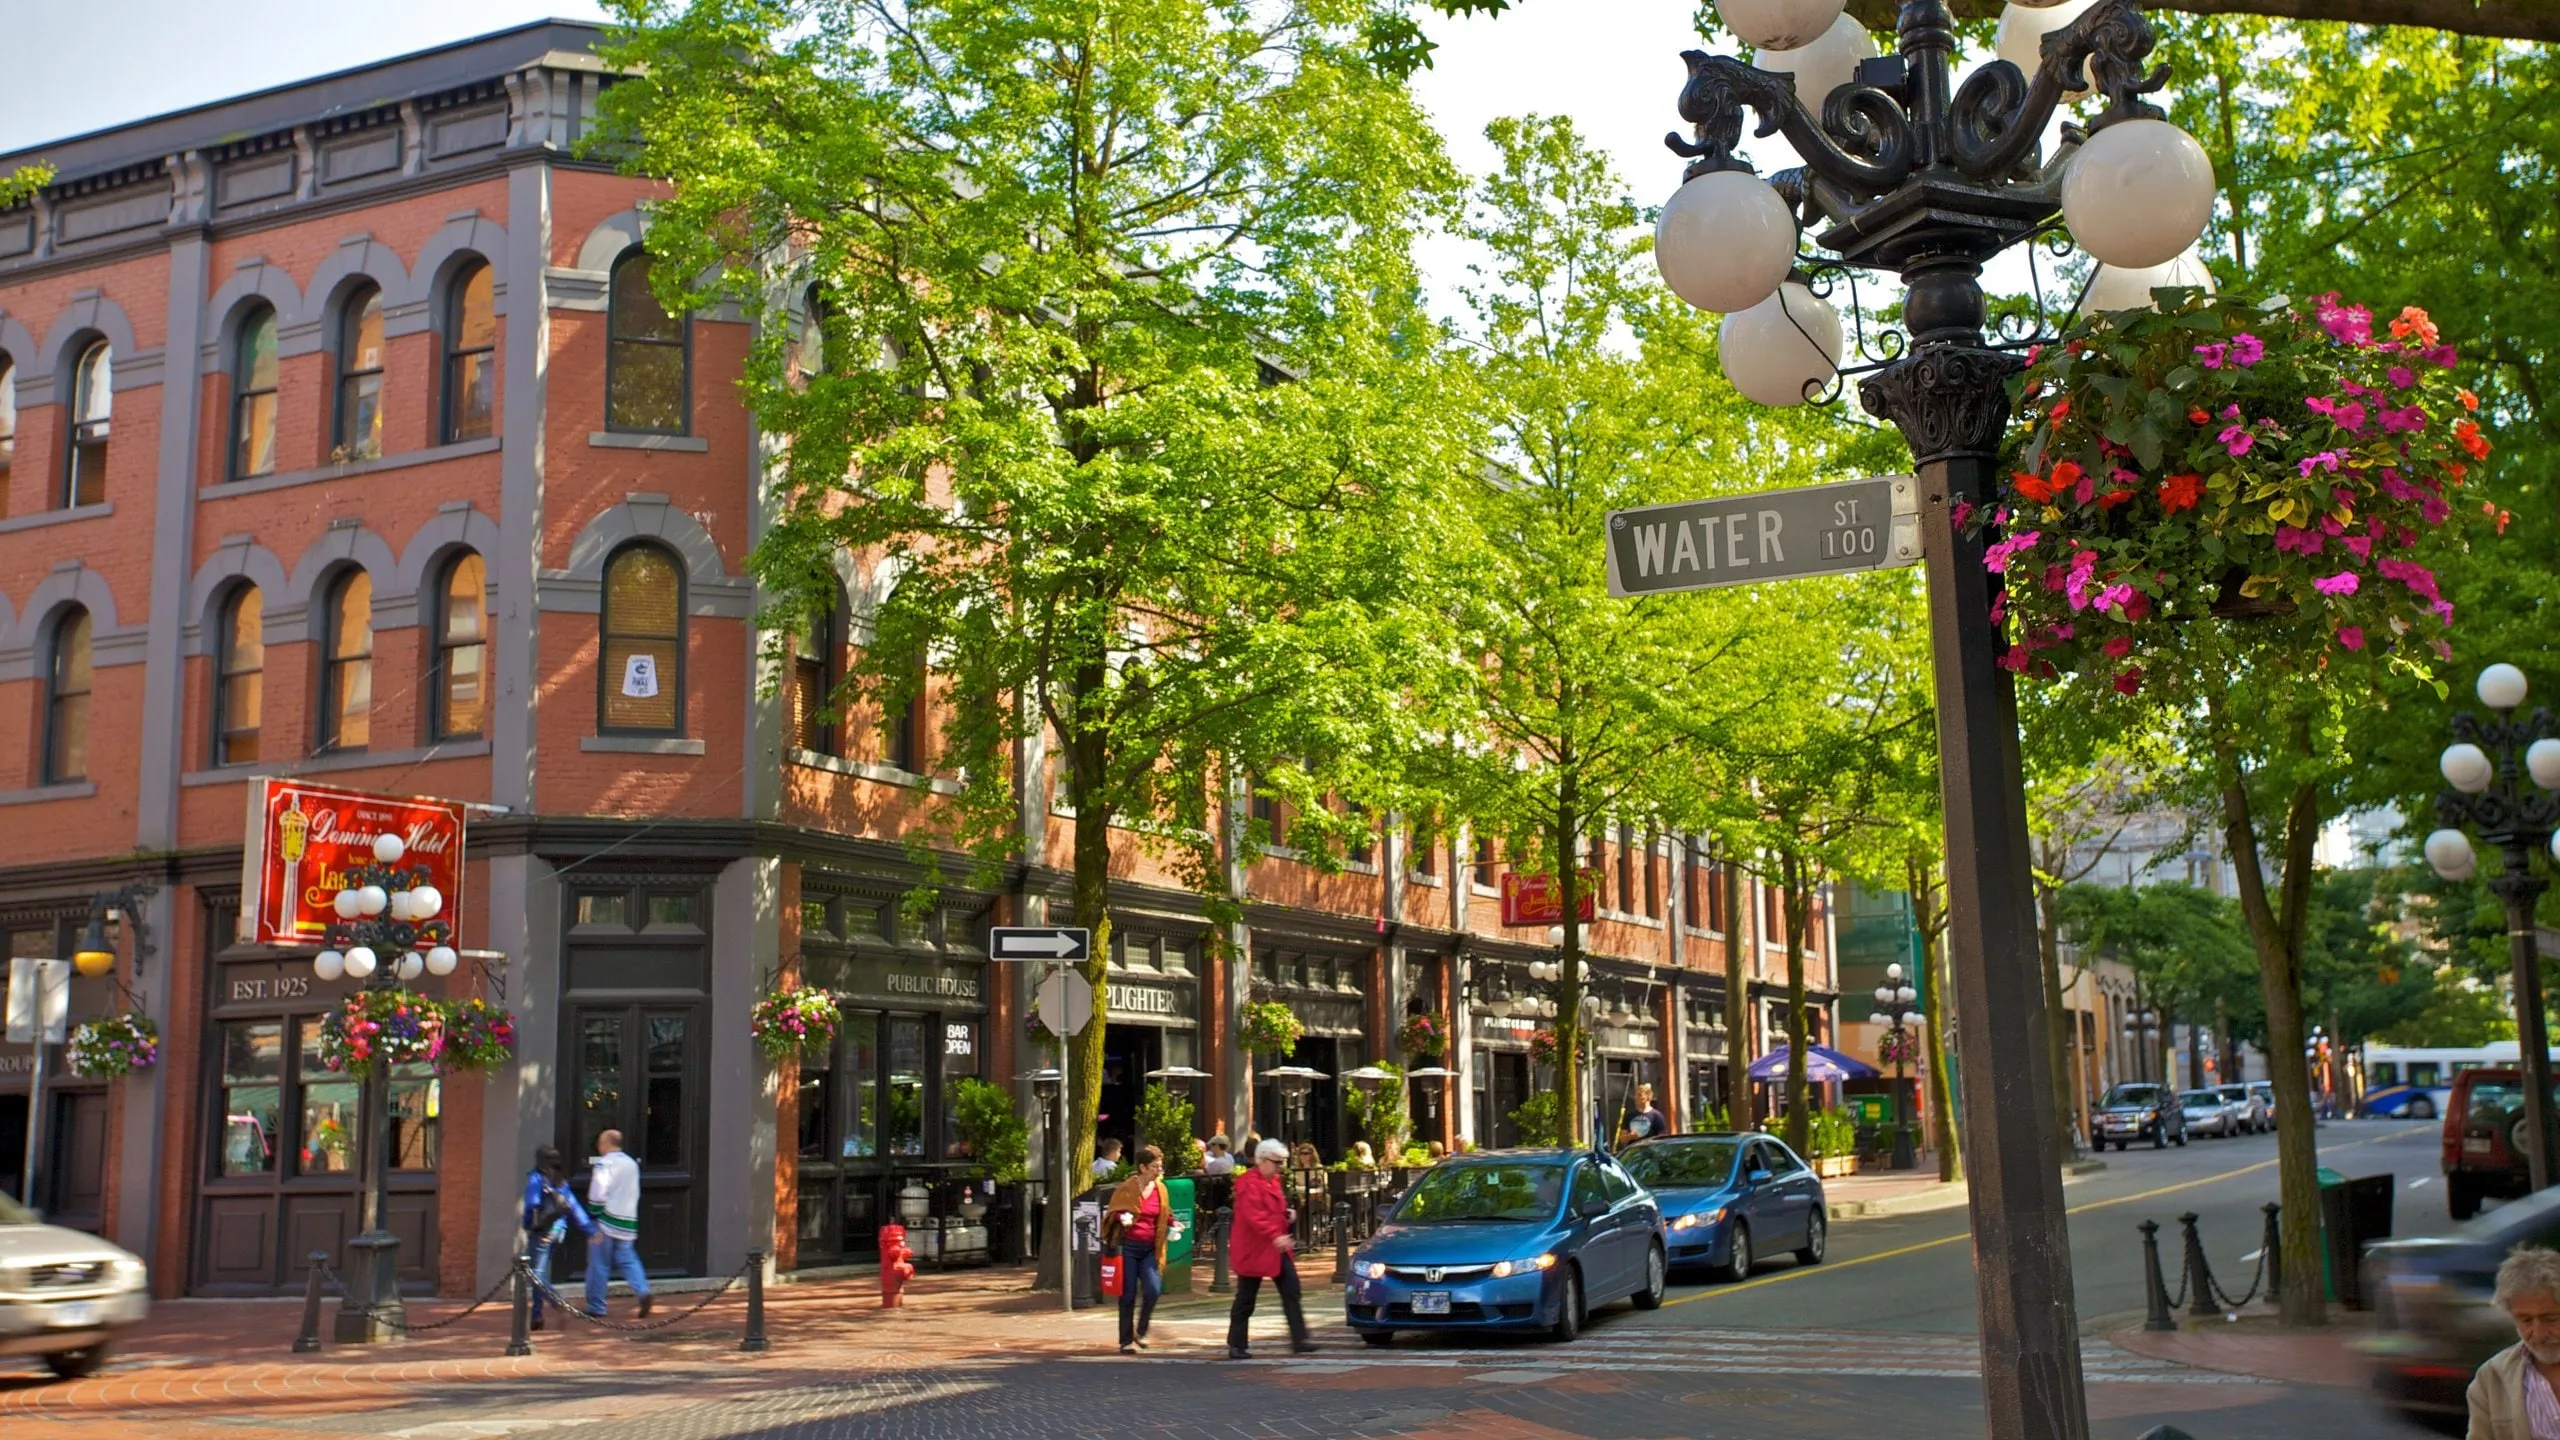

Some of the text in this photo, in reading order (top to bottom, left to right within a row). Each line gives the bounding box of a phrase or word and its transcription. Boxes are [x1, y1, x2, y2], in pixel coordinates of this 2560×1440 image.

[1834, 499, 1860, 526] ST
[1633, 510, 1785, 577] WATER
[1826, 527, 1875, 556] 100
[404, 820, 451, 855] Hotel
[233, 977, 308, 999] EST. 1925
[887, 973, 977, 997] PUBLIC HOUSE
[946, 1024, 968, 1039] BAR
